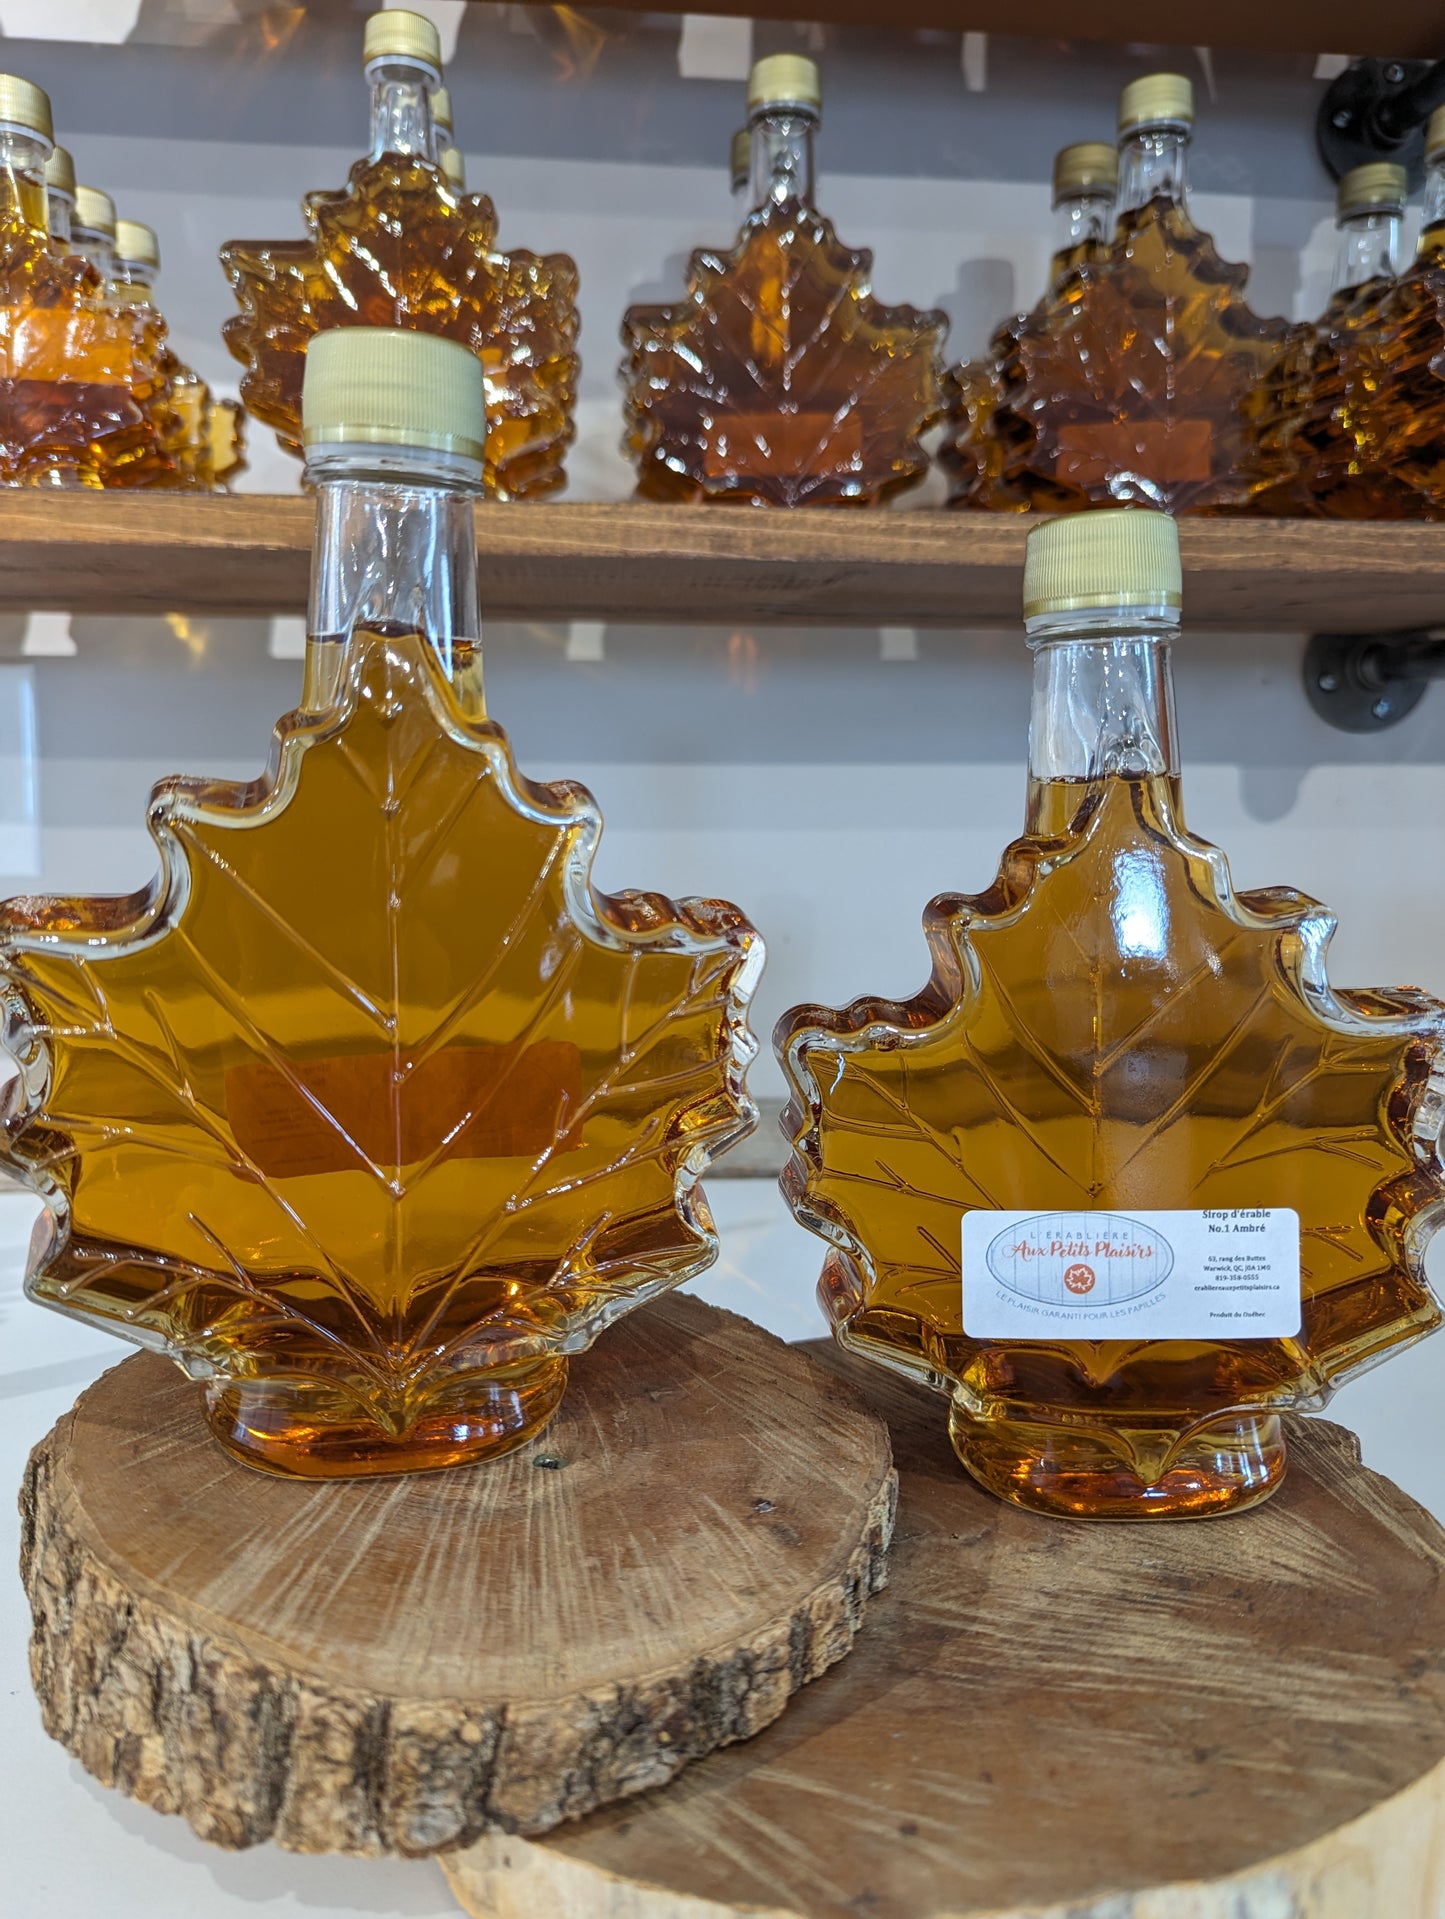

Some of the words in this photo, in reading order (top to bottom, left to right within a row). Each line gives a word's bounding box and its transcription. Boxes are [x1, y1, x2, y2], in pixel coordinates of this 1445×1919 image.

[1202, 1209, 1229, 1220] Sirop
[1231, 1209, 1271, 1219] d'érable
[1208, 1224, 1230, 1233] No.1
[1232, 1224, 1266, 1233] Ambré
[1001, 1240, 1049, 1262] Aux
[1050, 1240, 1092, 1258] Petits
[1094, 1240, 1153, 1259] Plaisirs
[995, 1290, 1006, 1302] LE
[1006, 1297, 1040, 1314] PLAISIR
[1041, 1309, 1082, 1320] GARANTI
[1083, 1311, 1109, 1320] POUR
[1110, 1308, 1126, 1319] LES
[1127, 1292, 1167, 1314] PAPILLES
